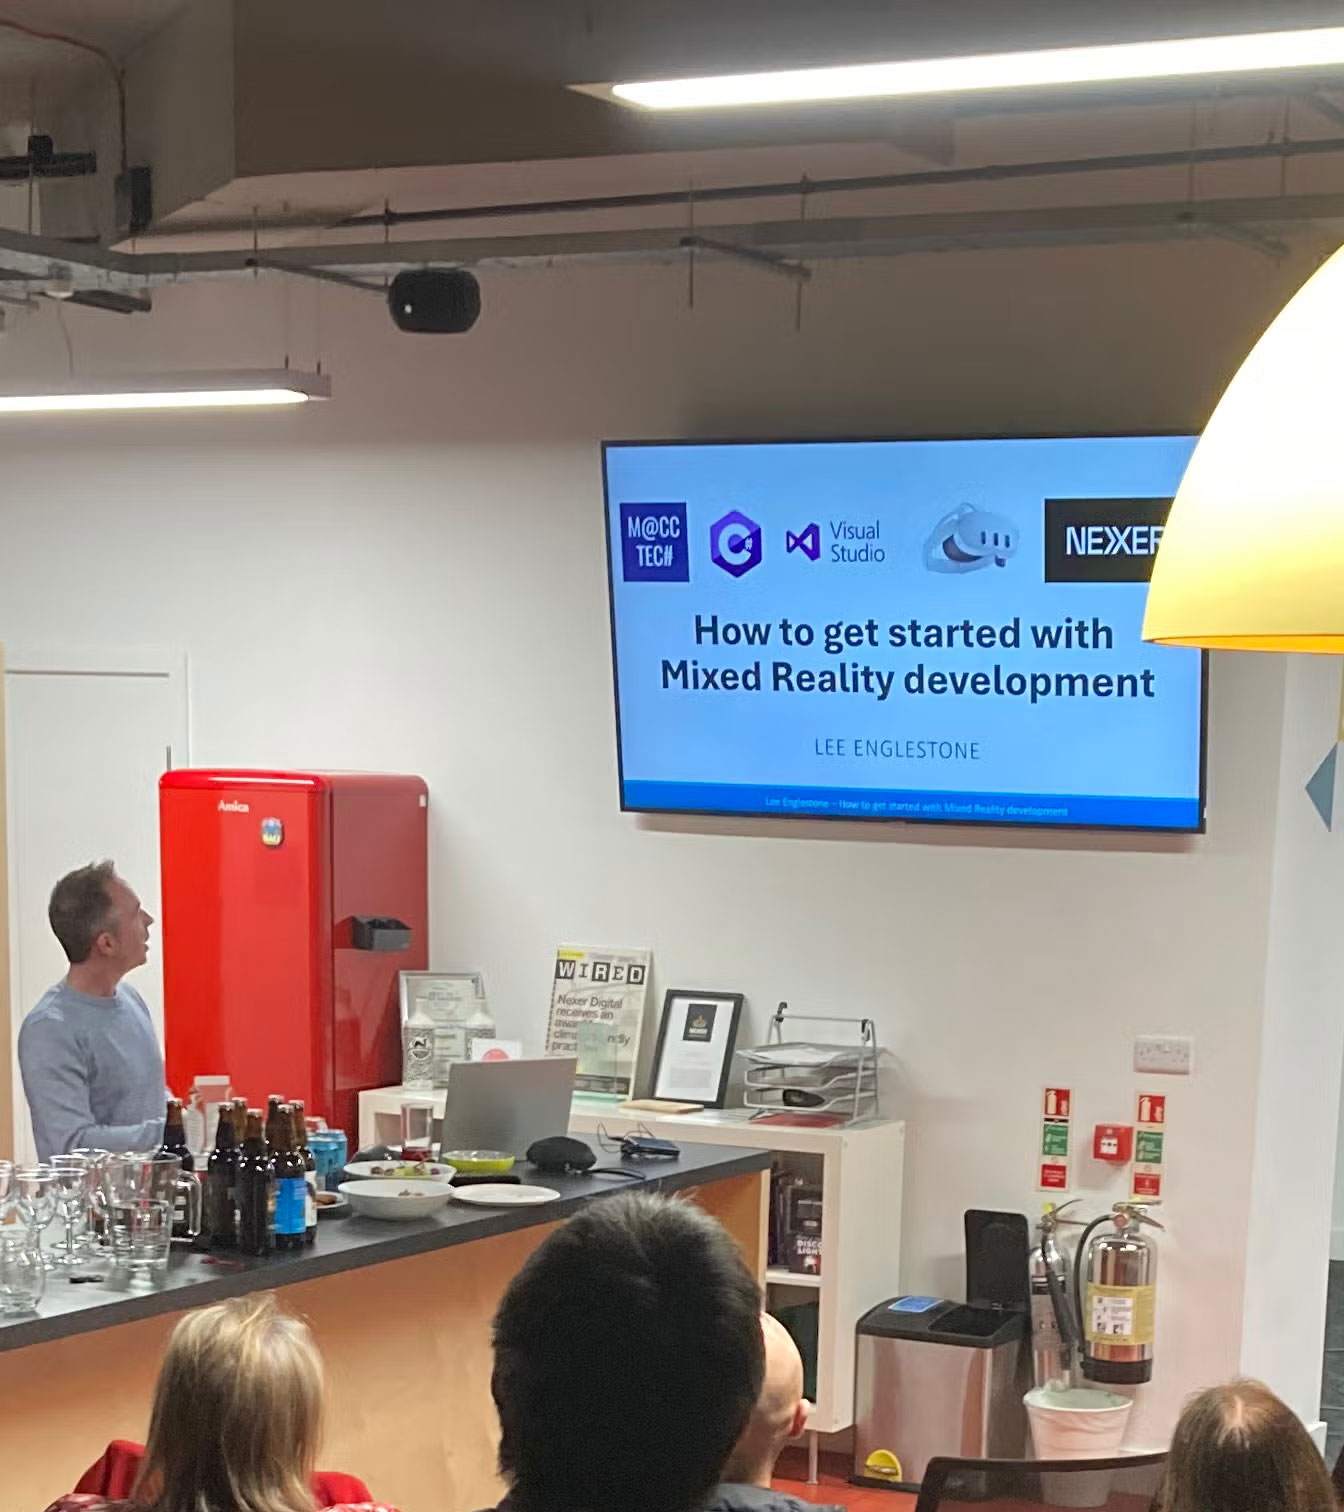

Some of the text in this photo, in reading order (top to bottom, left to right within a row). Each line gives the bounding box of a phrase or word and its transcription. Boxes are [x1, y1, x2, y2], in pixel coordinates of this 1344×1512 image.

[627, 515, 680, 542] M@CC
[830, 520, 881, 540] Visual
[635, 544, 674, 568] TEC#
[831, 543, 886, 563] Studio
[694, 614, 1114, 655] How to get started with
[661, 659, 1156, 705] Mixed Reality development
[815, 737, 982, 760] LEE ENGLESTONE
[217, 799, 250, 813] Amica
[556, 959, 646, 985] WIRED
[557, 994, 623, 1010] Nexer Digital
